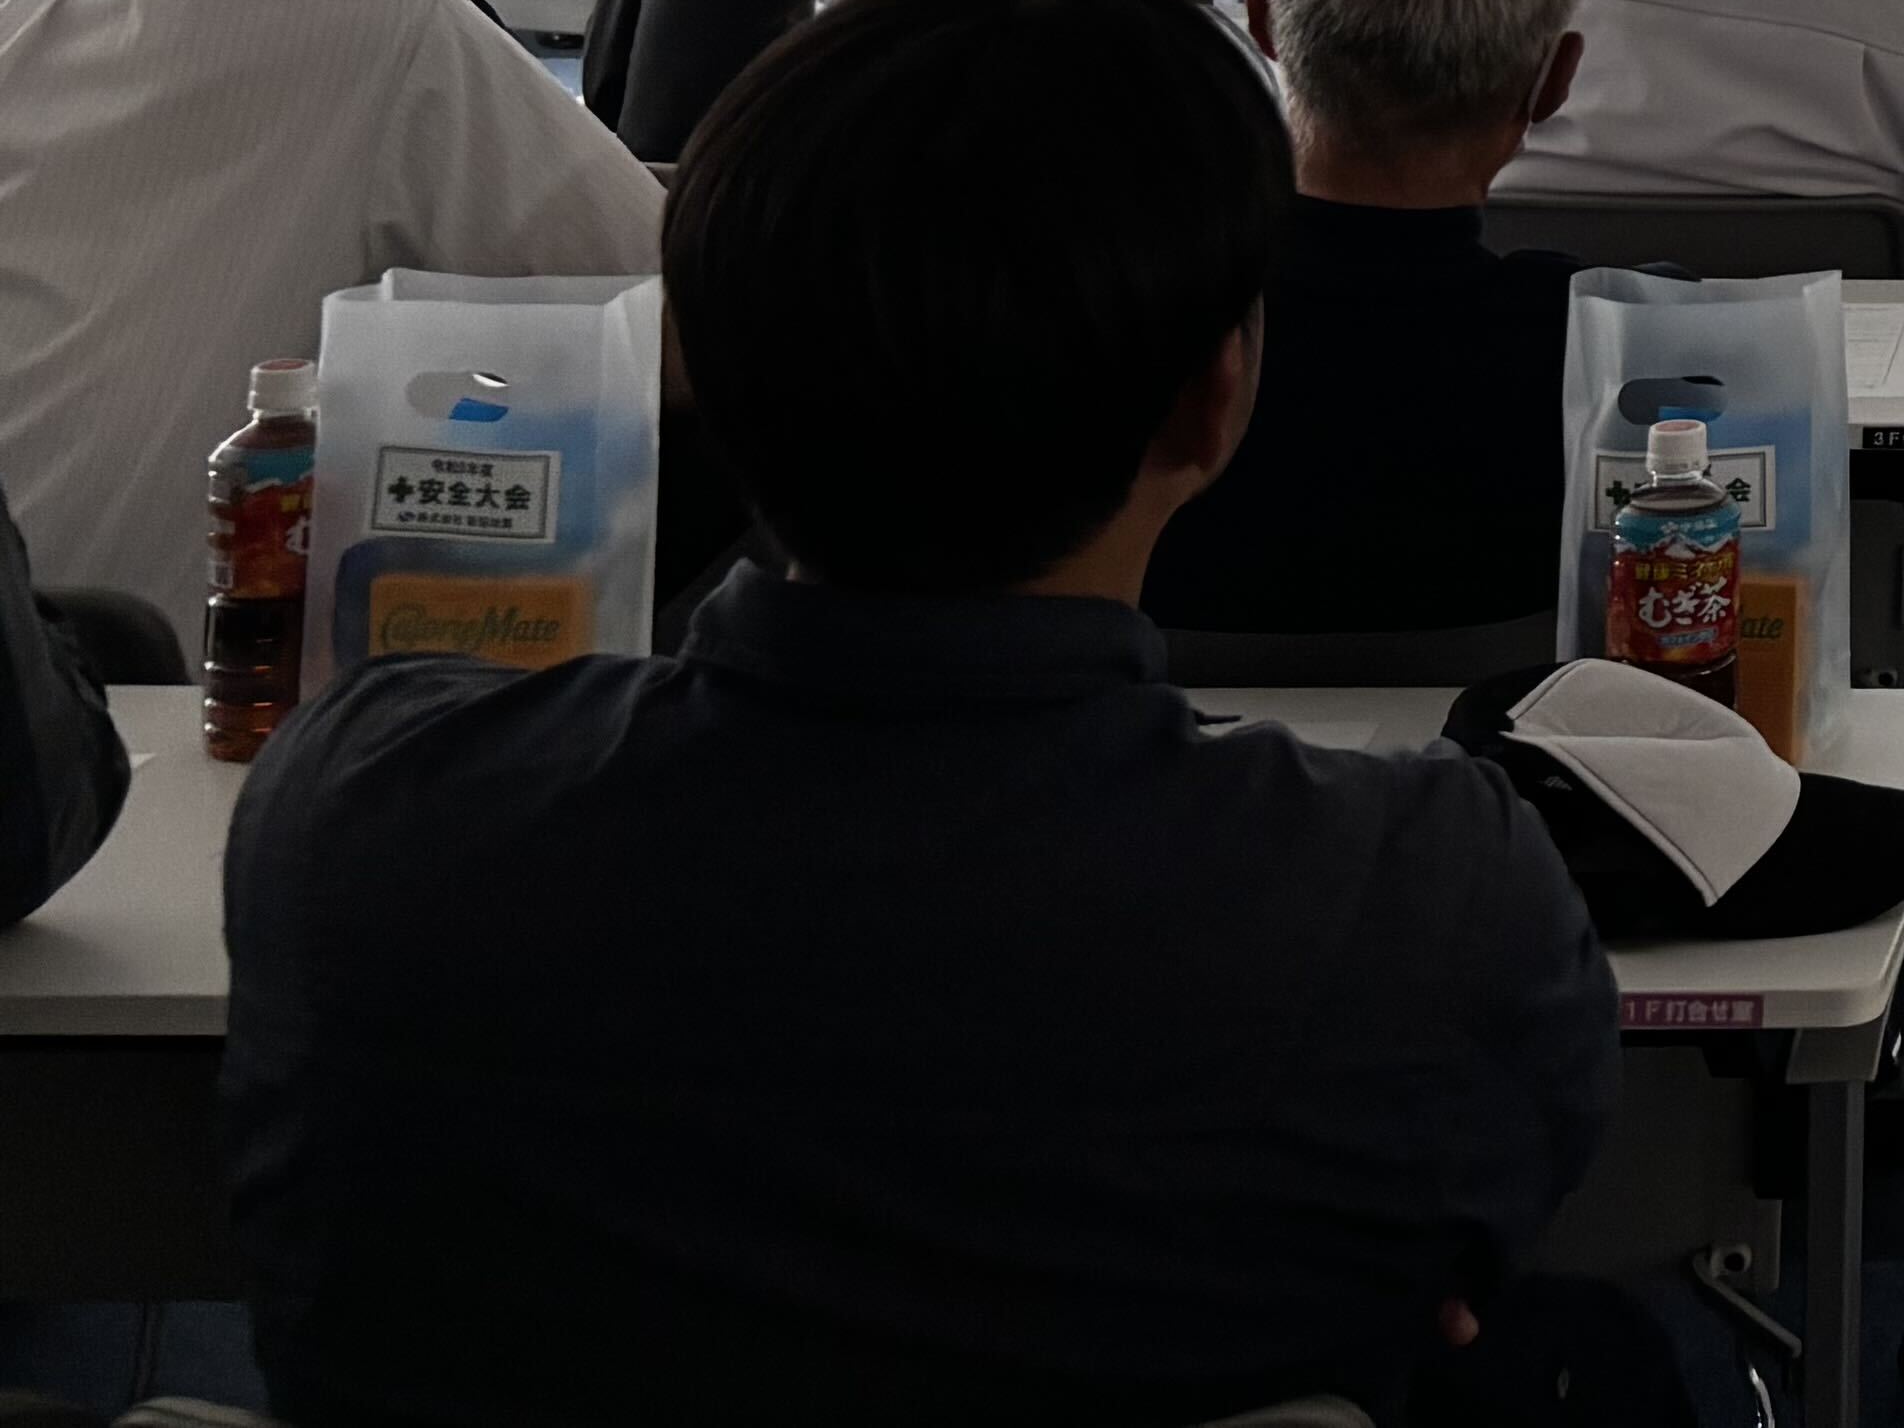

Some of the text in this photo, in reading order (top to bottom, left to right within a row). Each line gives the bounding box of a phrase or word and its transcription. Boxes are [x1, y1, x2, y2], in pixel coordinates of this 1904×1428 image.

[417, 477, 532, 512] 安全大会
[1638, 576, 1732, 629] むぎ茶
